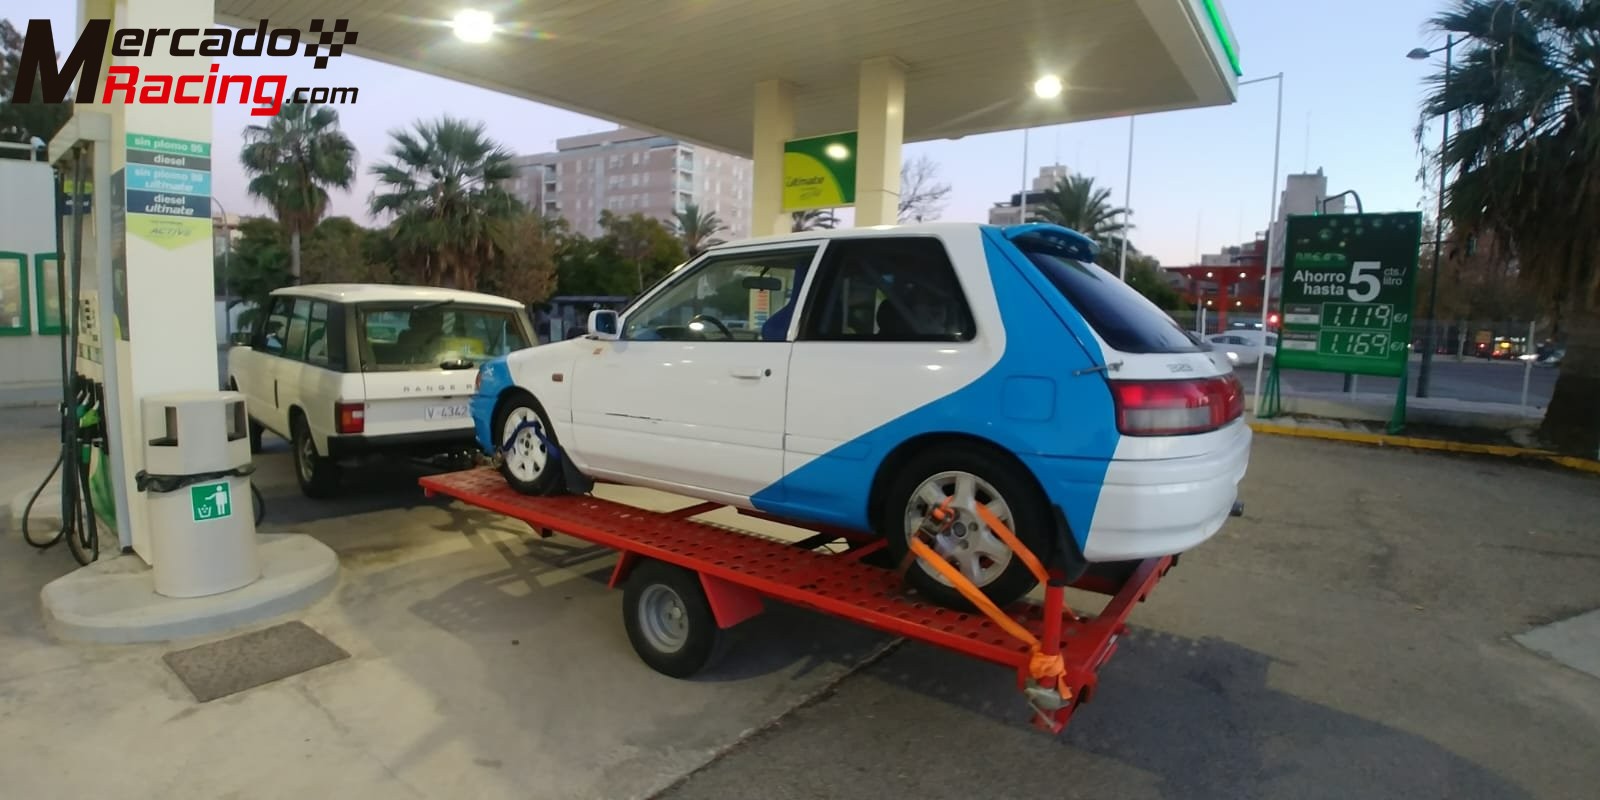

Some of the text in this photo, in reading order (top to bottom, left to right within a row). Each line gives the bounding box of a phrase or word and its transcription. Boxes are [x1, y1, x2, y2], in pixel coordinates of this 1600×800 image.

[134, 137, 151, 146] sin
[153, 139, 188, 151] plomo
[153, 154, 186, 166] diesel
[134, 168, 151, 177] sin
[153, 170, 189, 181] plomo
[145, 181, 194, 192] ultimate
[153, 194, 186, 205] diesel
[145, 204, 194, 215] ultimate
[1292, 269, 1346, 283] Ahorro
[1347, 261, 1382, 302] 5
[1383, 276, 1403, 286] litro
[1303, 283, 1345, 295] hasta
[403, 385, 455, 393] RANGE
